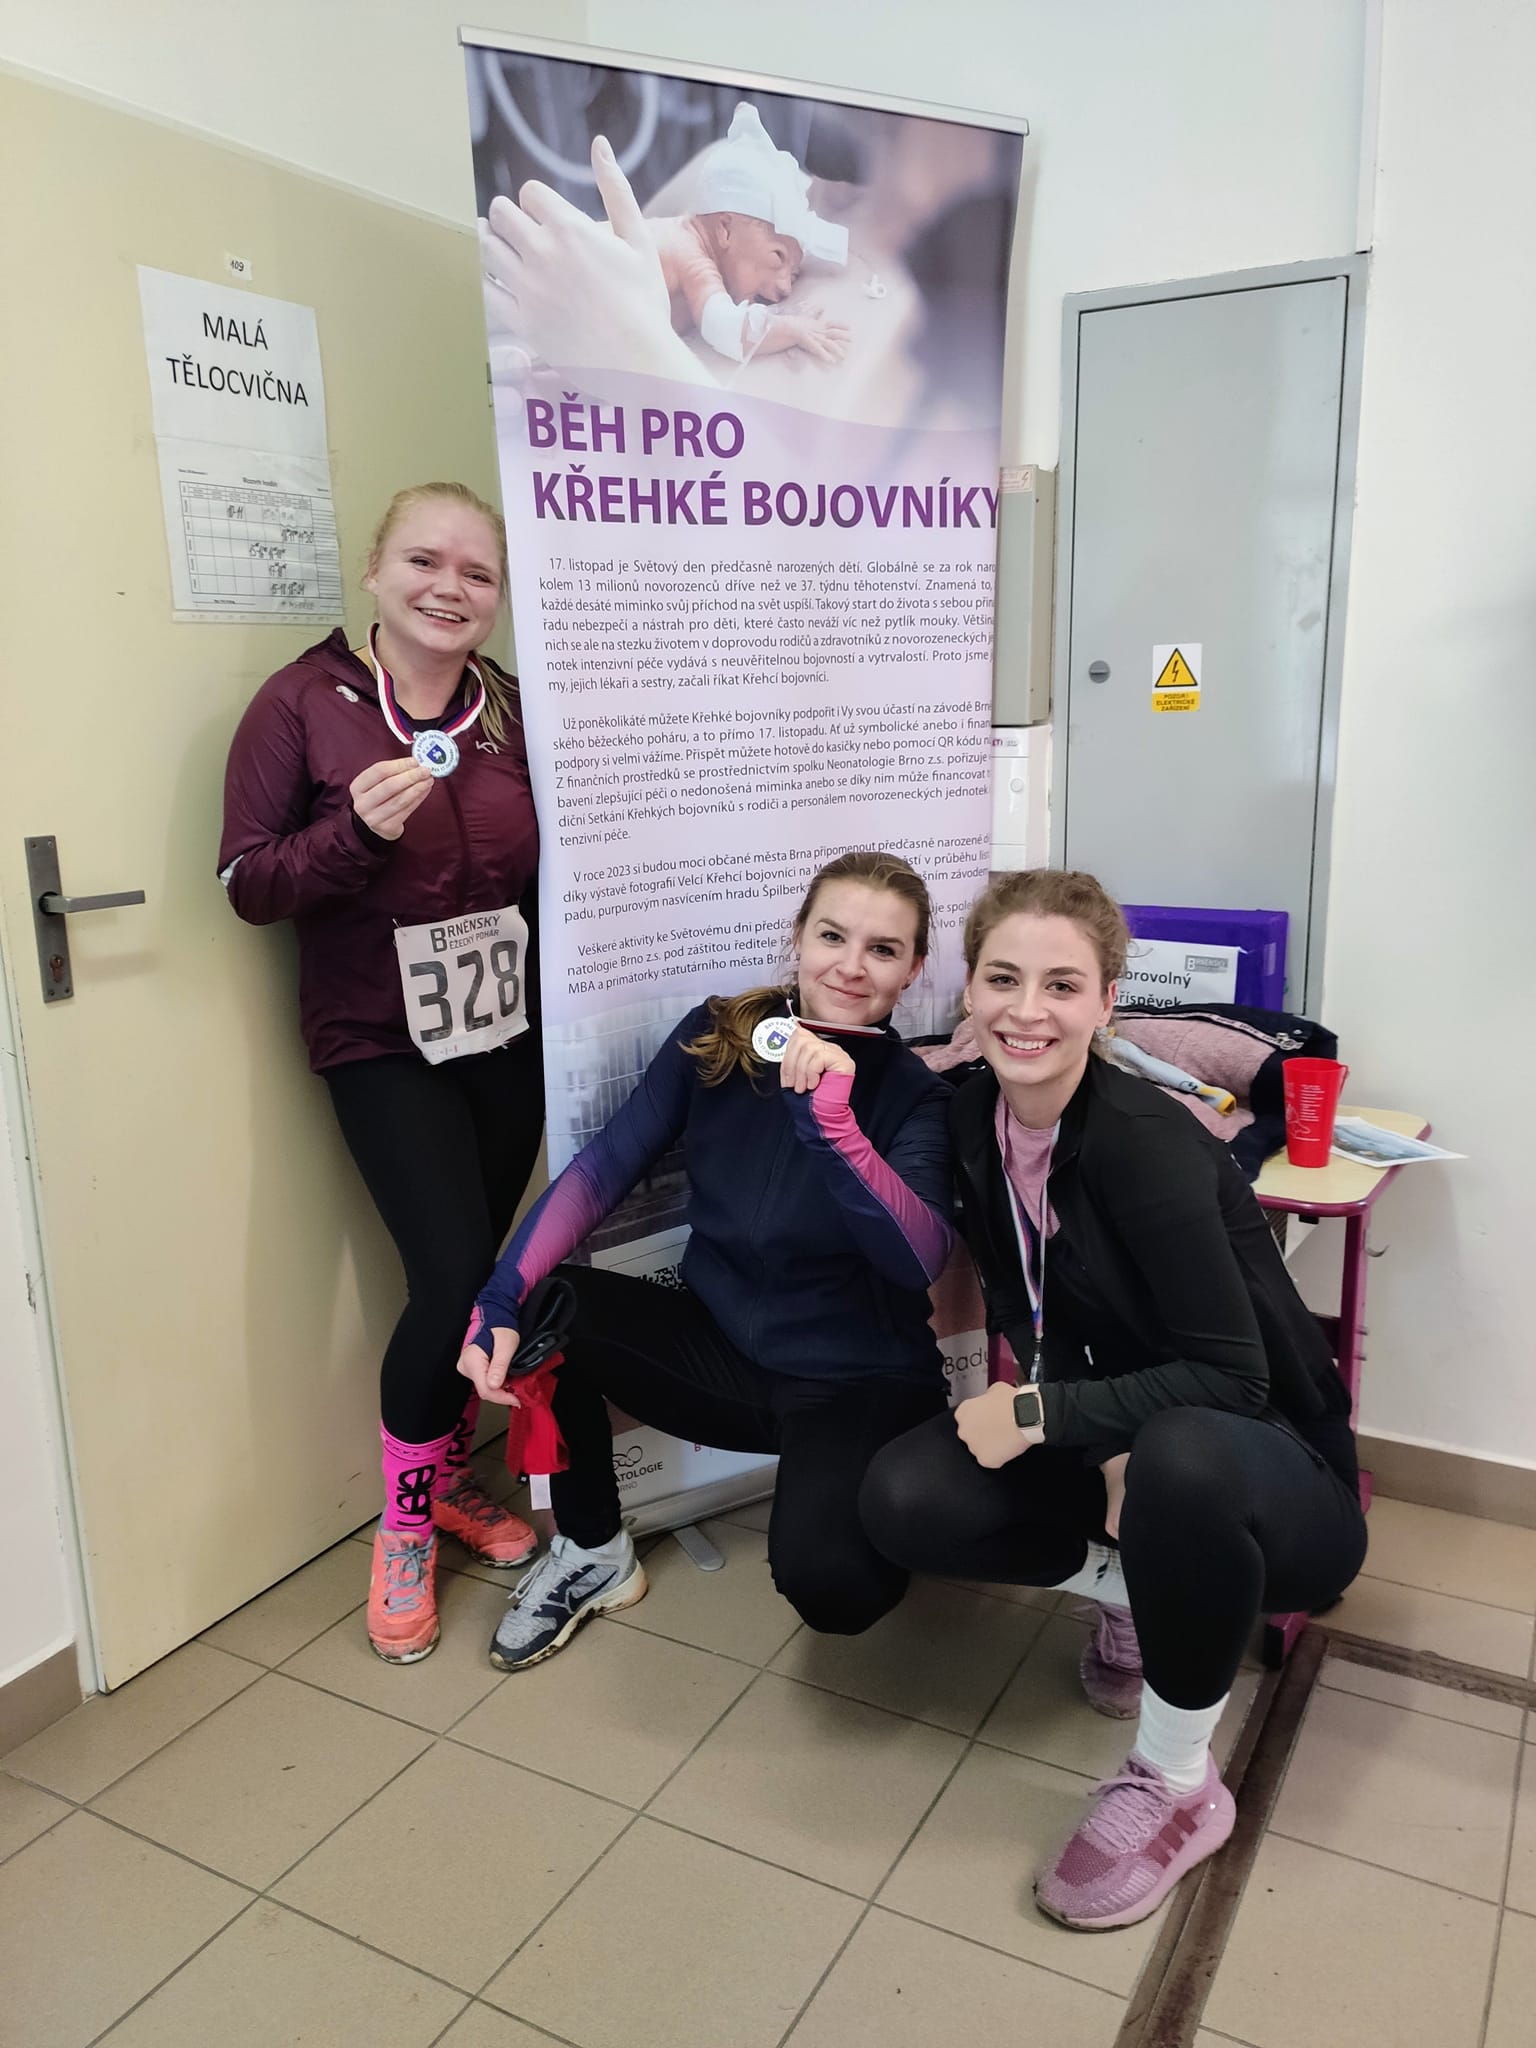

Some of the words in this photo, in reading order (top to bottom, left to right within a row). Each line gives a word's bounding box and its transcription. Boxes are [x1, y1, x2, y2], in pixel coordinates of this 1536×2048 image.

[202, 312, 268, 350] MALÁ
[166, 353, 309, 407] TĚLOCVIČNA
[526, 391, 625, 454] BĚH
[642, 407, 745, 459] PRO
[533, 463, 728, 526] KŘEHKÉ
[743, 476, 998, 528] BOJOVNÍKY
[569, 558, 613, 574] listopad
[634, 560, 678, 575] Světový
[711, 560, 772, 575] předčasně
[777, 561, 834, 576] narozených
[839, 561, 862, 573] dětí.
[867, 561, 918, 573] Globálně
[540, 577, 573, 590] kolem
[596, 579, 639, 591] milionů
[645, 580, 719, 592] novorozenců
[725, 580, 755, 591] dříve
[820, 580, 849, 594] týdnu
[854, 579, 920, 591] těhotenství.
[926, 579, 976, 590] Znamená
[541, 597, 573, 610] každé
[576, 598, 611, 611] desáté
[614, 599, 663, 611] miminko
[666, 599, 688, 614] svůj
[692, 598, 737, 613] příchod
[758, 598, 780, 610] svět
[784, 598, 814, 612] uspíší.
[815, 598, 850, 612] Takový
[853, 600, 876, 609] start
[897, 598, 929, 608] života
[940, 597, 972, 608] sebou
[544, 618, 568, 630] řadu
[573, 619, 627, 634] nebezpečí
[643, 618, 684, 630] nástrah
[714, 618, 739, 630] děti,
[745, 617, 773, 628] které
[778, 617, 804, 628] často
[808, 616, 839, 628] neváží
[885, 615, 915, 630] pytlík
[920, 614, 959, 628] mouky.
[545, 638, 568, 651] nich
[617, 638, 651, 650] stezku
[654, 638, 699, 649] životem
[712, 636, 776, 651] doprovodu
[780, 635, 811, 646] rodičů
[821, 634, 881, 646] zdravotníků
[892, 632, 987, 645] novorozeneckých
[547, 658, 578, 671] notek
[581, 658, 633, 670] intenzivní
[637, 657, 663, 672] péče
[667, 656, 707, 671] vydává
[722, 654, 799, 666] neuvěřitelnou
[804, 652, 855, 667] bojovností
[868, 651, 928, 665] vytrvalostí.
[933, 650, 961, 661] Proto
[965, 650, 989, 663] jsme
[570, 677, 597, 693] jejich
[600, 677, 629, 689] lékaři
[641, 678, 675, 690] sestry,
[678, 674, 709, 686] začali
[714, 674, 739, 685] říkat
[743, 672, 778, 684] Křehcí
[781, 671, 829, 686] bojovníci.
[579, 714, 646, 732] poněkolikáté
[649, 713, 689, 725] můžete
[692, 711, 732, 723] Křehké
[736, 709, 790, 724] bojovníky
[793, 706, 835, 722] podpořit
[856, 707, 880, 716] svou
[883, 703, 915, 715] účastí
[934, 701, 972, 713] závodě
[553, 737, 584, 750] ského
[588, 733, 643, 747] běžeckého
[648, 732, 689, 747] poháru,
[720, 729, 754, 743] přímo
[779, 724, 827, 739] listopadu.
[859, 720, 918, 736] symbolické
[923, 719, 957, 730] anebo
[555, 756, 599, 772] podpory
[612, 752, 640, 765] velmi
[643, 751, 683, 763] vážíme.
[686, 748, 725, 762] Přispět
[729, 746, 771, 758] můžete
[774, 743, 810, 756] hotově
[827, 740, 861, 753] kasičky
[863, 739, 890, 750] nebo
[893, 737, 935, 751] pomocí
[956, 735, 982, 746] kódu
[567, 772, 619, 788] finančních
[623, 768, 680, 786] prostředků
[699, 761, 789, 780] prostřednictvím
[793, 760, 824, 775] spolku
[827, 756, 895, 770] Neonatologie
[899, 755, 924, 765] Brno
[558, 796, 592, 808] bavení
[596, 791, 642, 806] zlepšující
[681, 784, 751, 797] nedonošená
[756, 779, 802, 792] miminka
[806, 777, 834, 789] anebo
[850, 774, 871, 787] díky
[899, 771, 928, 782] může
[932, 770, 985, 781] financovat
[559, 815, 585, 827] diční
[588, 811, 624, 824] Setkání
[628, 805, 675, 820] Křehkých
[679, 801, 734, 817] bojovníků
[748, 799, 778, 810] rodiči
[791, 794, 846, 811] personálem
[849, 787, 942, 802] novorozeneckých
[945, 785, 991, 800] jednotek
[605, 828, 630, 844] péče.
[584, 871, 604, 881] roce
[607, 865, 630, 878] 2023
[643, 860, 676, 873] budou
[679, 856, 705, 869] moci
[709, 853, 751, 866] občané
[754, 851, 787, 863] města
[876, 838, 934, 854] předčasně
[938, 834, 982, 847] narozené
[590, 883, 626, 901] výstavě
[678, 874, 703, 886] Velcí
[707, 871, 742, 883] Křehcí
[746, 867, 795, 882] bojovníci
[935, 852, 977, 866] průběhu
[565, 907, 596, 924] padu,
[599, 899, 659, 919] purpurovým
[662, 890, 722, 906] nasvícením
[726, 887, 759, 899] hradu
[568, 960, 618, 977] natologie
[687, 943, 730, 955] záštitou
[735, 937, 777, 950] ředitele
[578, 943, 617, 956] Veškeré
[619, 935, 654, 949] aktivity
[671, 926, 731, 940] Světovému
[606, 966, 659, 989] primátorky
[662, 959, 726, 977] statutárního
[730, 956, 763, 967] města
[1117, 970, 1191, 989] brovolný
[409, 940, 520, 1043] 328
